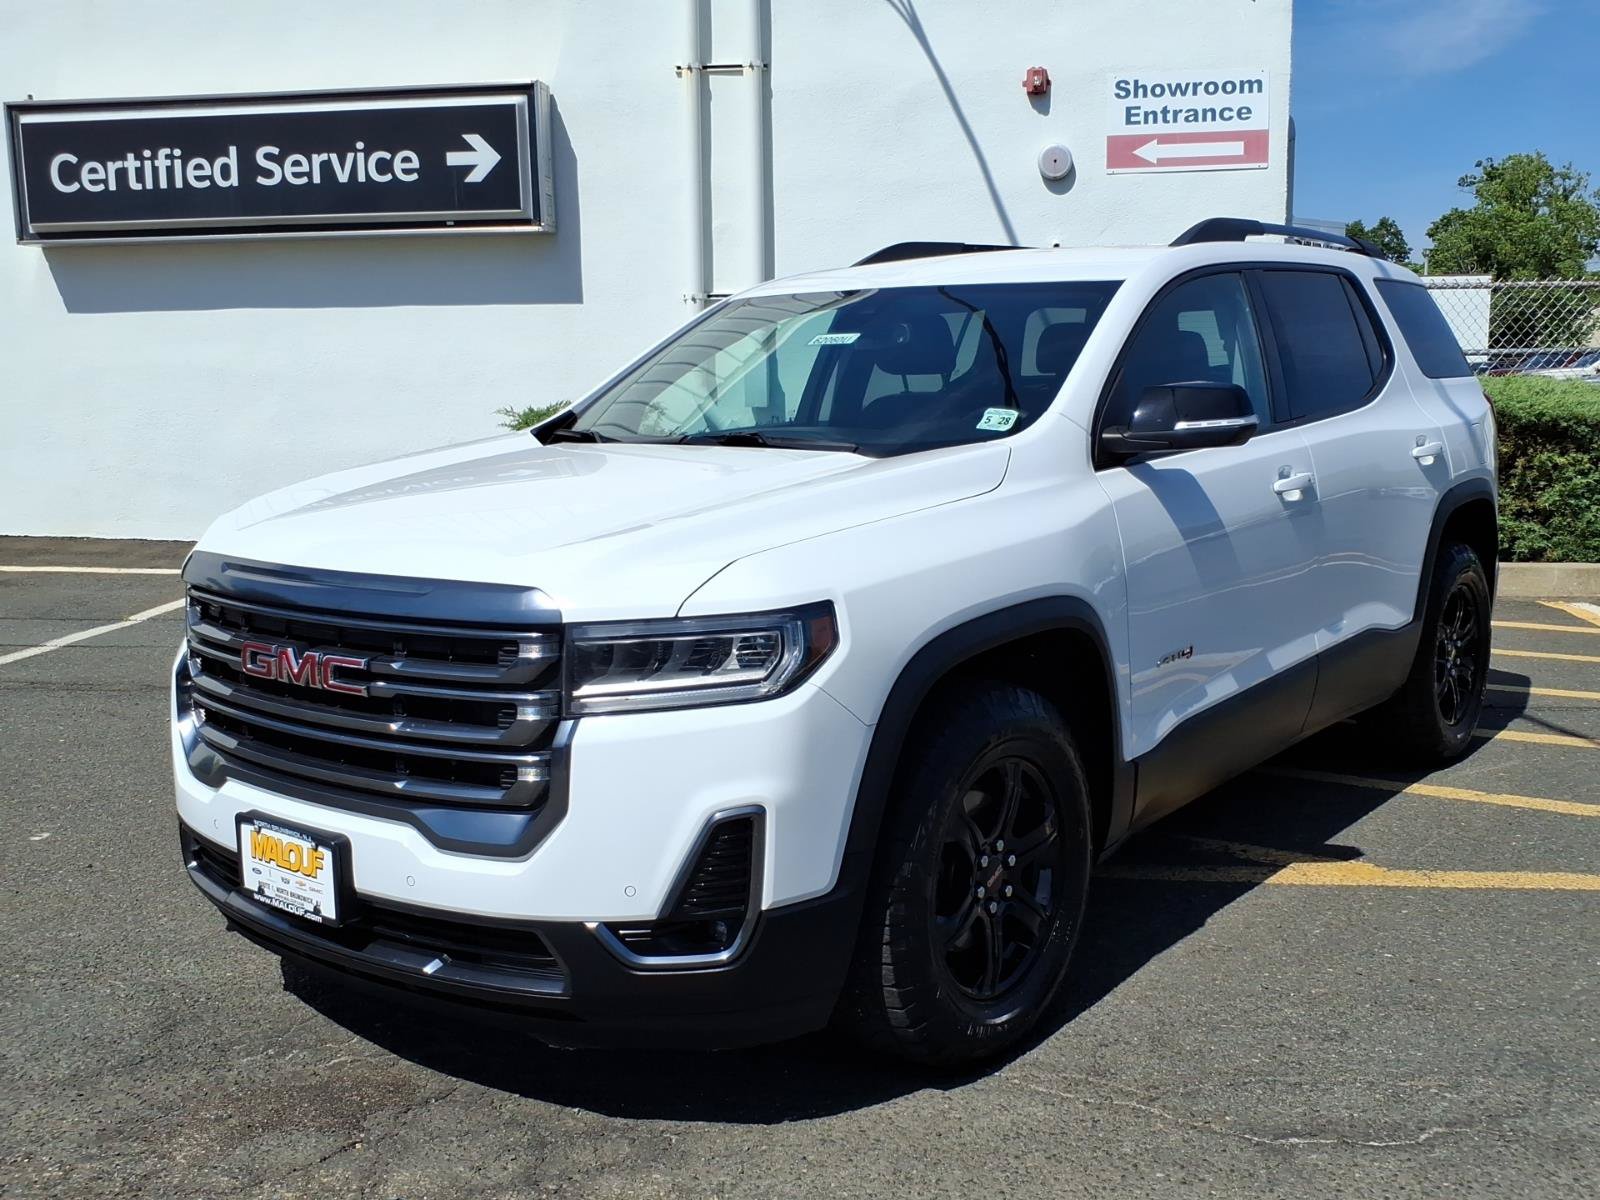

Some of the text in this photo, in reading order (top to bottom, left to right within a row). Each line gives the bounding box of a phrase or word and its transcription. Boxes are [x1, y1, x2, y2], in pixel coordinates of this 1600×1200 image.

[1114, 78, 1263, 100] Showroom
[1124, 104, 1253, 126] Entrance
[49, 141, 419, 193] Certified Service
[984, 415, 1012, 426] 5 28
[240, 640, 369, 698] GMC
[249, 830, 325, 879] MALOUF
